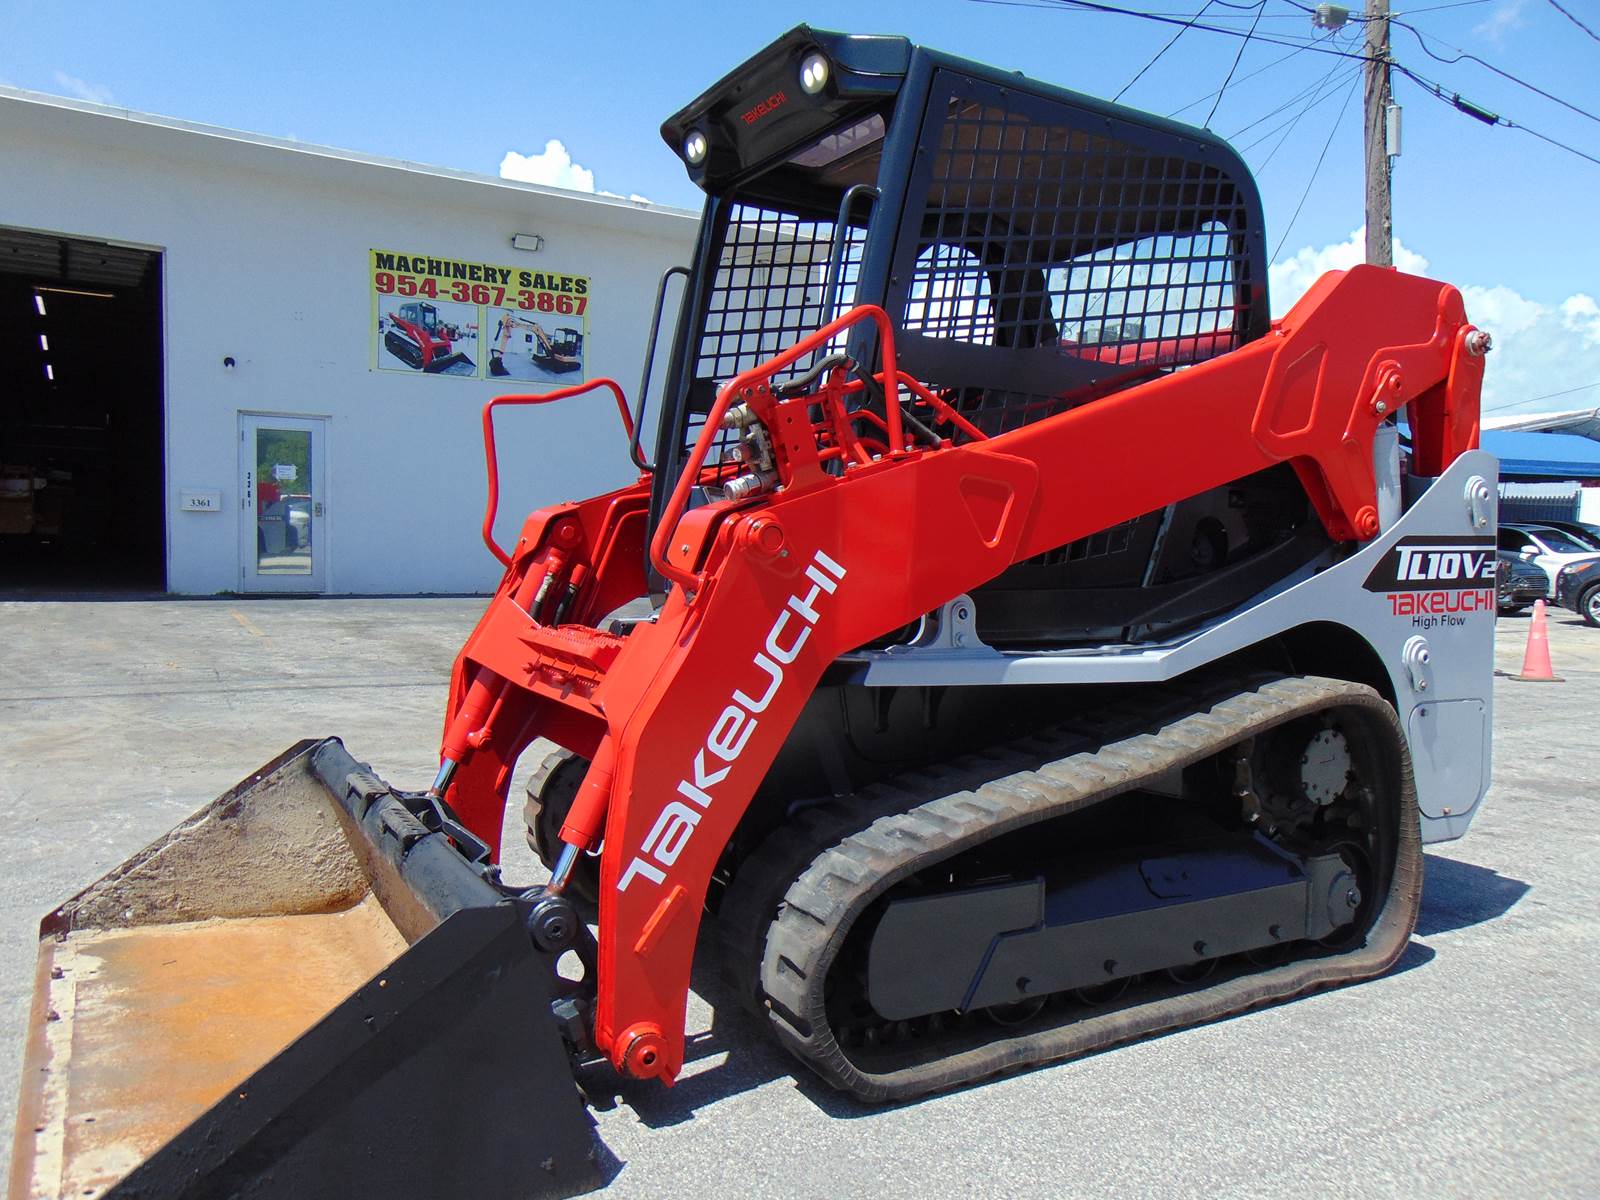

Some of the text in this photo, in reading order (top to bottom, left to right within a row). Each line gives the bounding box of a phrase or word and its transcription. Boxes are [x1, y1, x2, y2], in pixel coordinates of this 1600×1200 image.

[375, 252, 588, 294] MACHINERY SALES
[375, 272, 588, 316] 954-367-3867
[190, 499, 211, 507] 3361
[1412, 615, 1466, 630] High Flow
